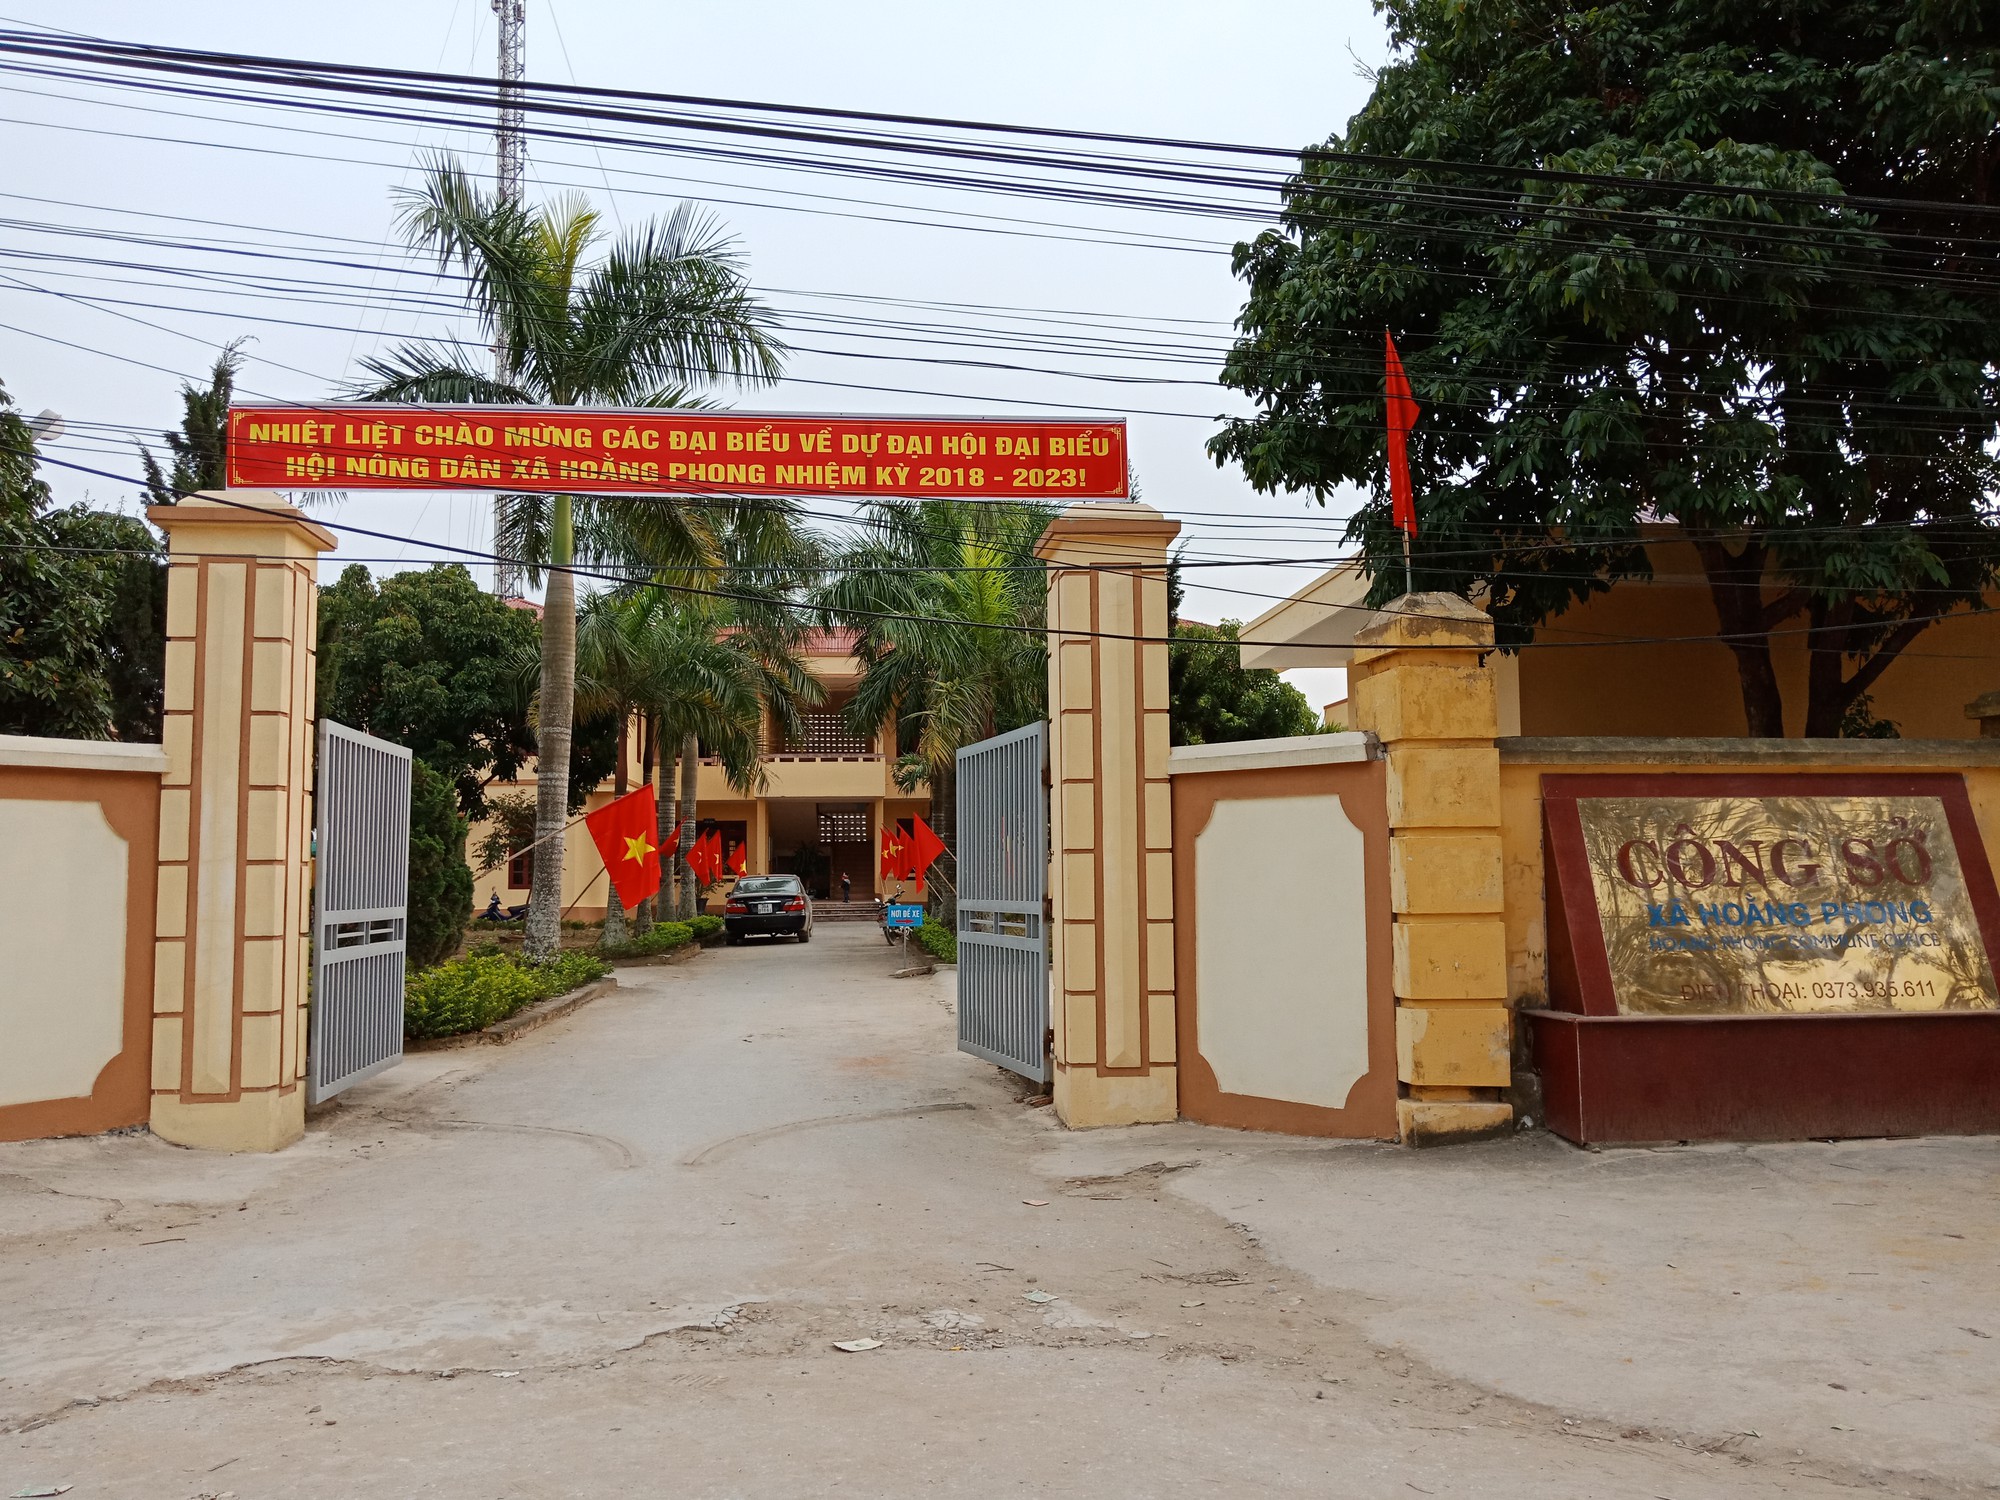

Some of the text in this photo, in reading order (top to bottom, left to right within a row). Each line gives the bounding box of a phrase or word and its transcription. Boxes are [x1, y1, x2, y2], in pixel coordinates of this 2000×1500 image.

[250, 419, 1109, 460] NHIỆT LIỆT CHÀO MỪNG CÁC ĐẠI BIỂU VỀ DỰ ĐẠI HỘI ĐẠI BIỂU
[286, 453, 335, 481] HỘI
[346, 453, 430, 478] NÔNG
[440, 455, 501, 479] DÂN
[511, 456, 550, 479] XÃ
[560, 452, 659, 482] HOẰNG
[669, 463, 766, 484] PHONG
[775, 462, 866, 489] NHIỆM
[876, 463, 910, 486] KỲ
[919, 467, 985, 487] 2018
[1012, 468, 1086, 487] 2023!
[1616, 816, 1933, 889] CÔNG SỞ
[1821, 901, 1933, 925] PHONG
[1812, 980, 1935, 999] 0373.935.611
